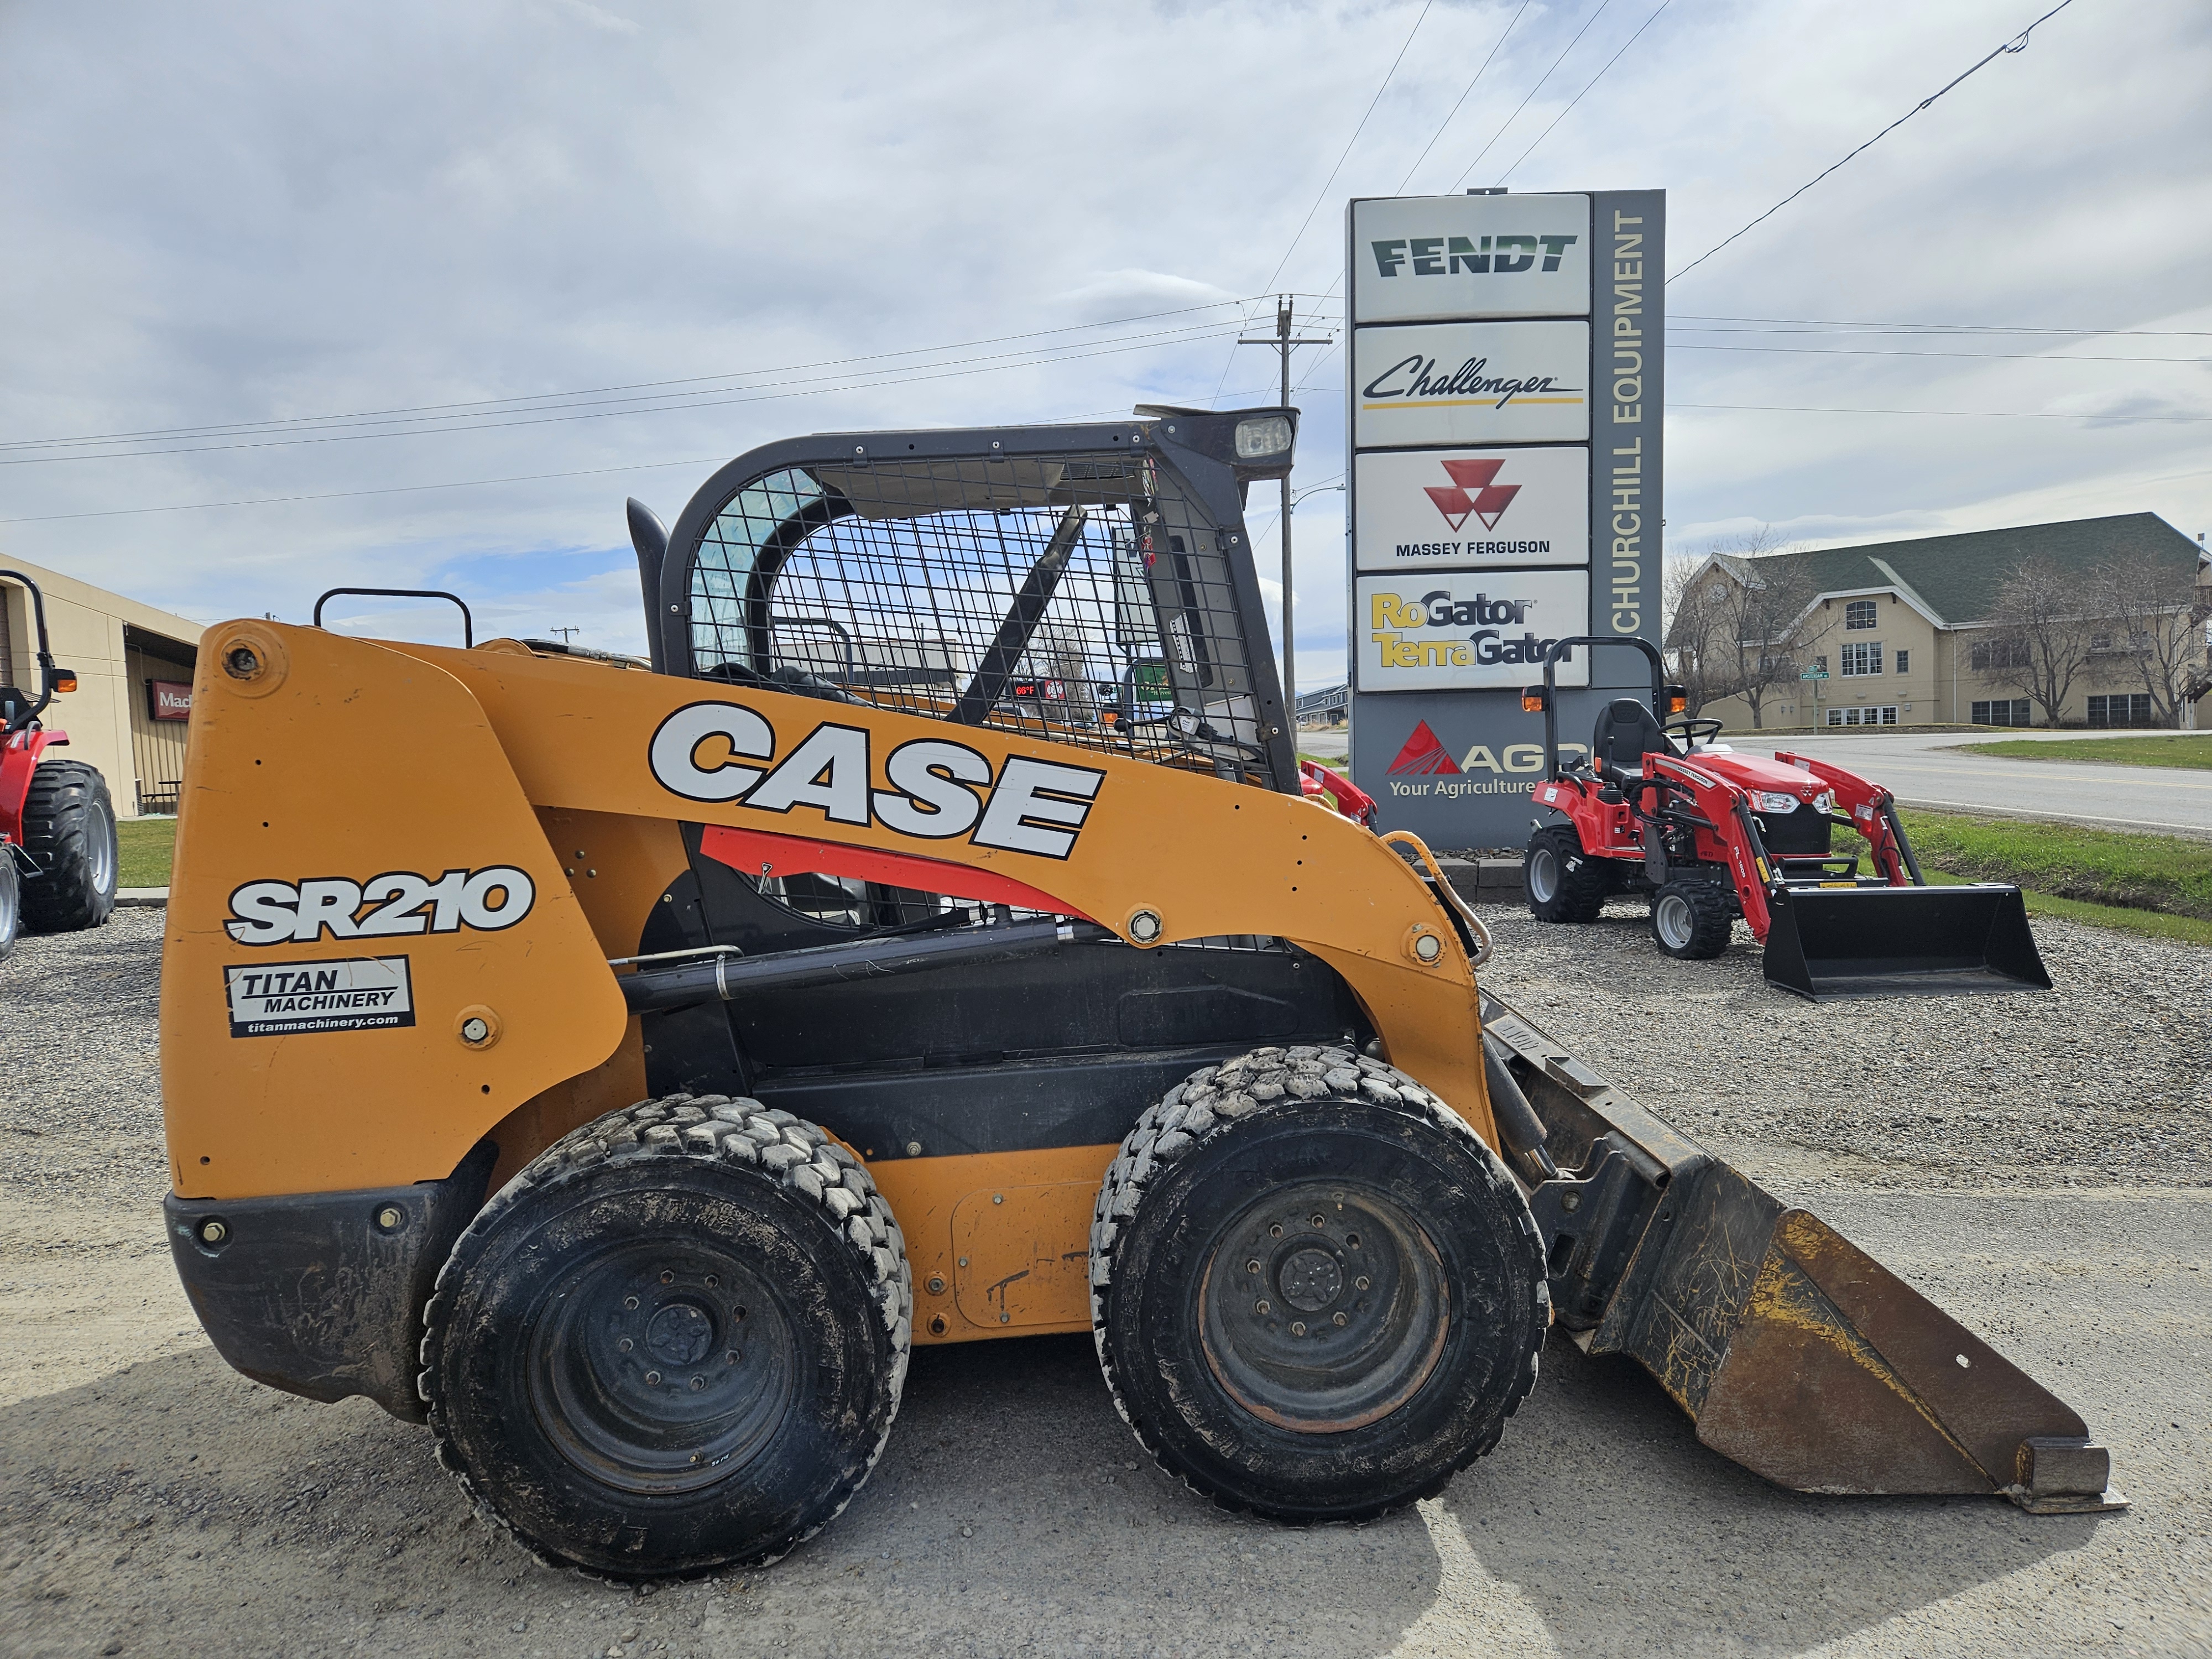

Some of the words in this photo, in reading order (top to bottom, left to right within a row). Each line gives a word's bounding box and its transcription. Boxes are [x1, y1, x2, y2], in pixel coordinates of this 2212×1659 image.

[1371, 235, 1578, 277] FENDT
[1613, 210, 1643, 424] EQUIPMENT
[1363, 354, 1583, 409] Challenger
[1612, 436, 1642, 633] CHURCHILL
[1396, 542, 1461, 557] MASSEY
[1467, 540, 1550, 554] FERGUSON
[1371, 590, 1532, 629] RoGator
[1016, 686, 1035, 695] 66°F
[1460, 743, 1595, 773] AGC
[648, 700, 1107, 861] CASE
[1390, 781, 1430, 796] Your
[1434, 779, 1536, 798] Agriculture
[1678, 766, 1691, 775] MASSEY
[1691, 773, 1708, 784] FERGUSON
[1734, 846, 1740, 859] FL
[223, 865, 536, 946] SR210
[242, 970, 338, 995] TITAN
[264, 991, 395, 1013] MACHINERY
[247, 1015, 398, 1033] titanmachinery.com
